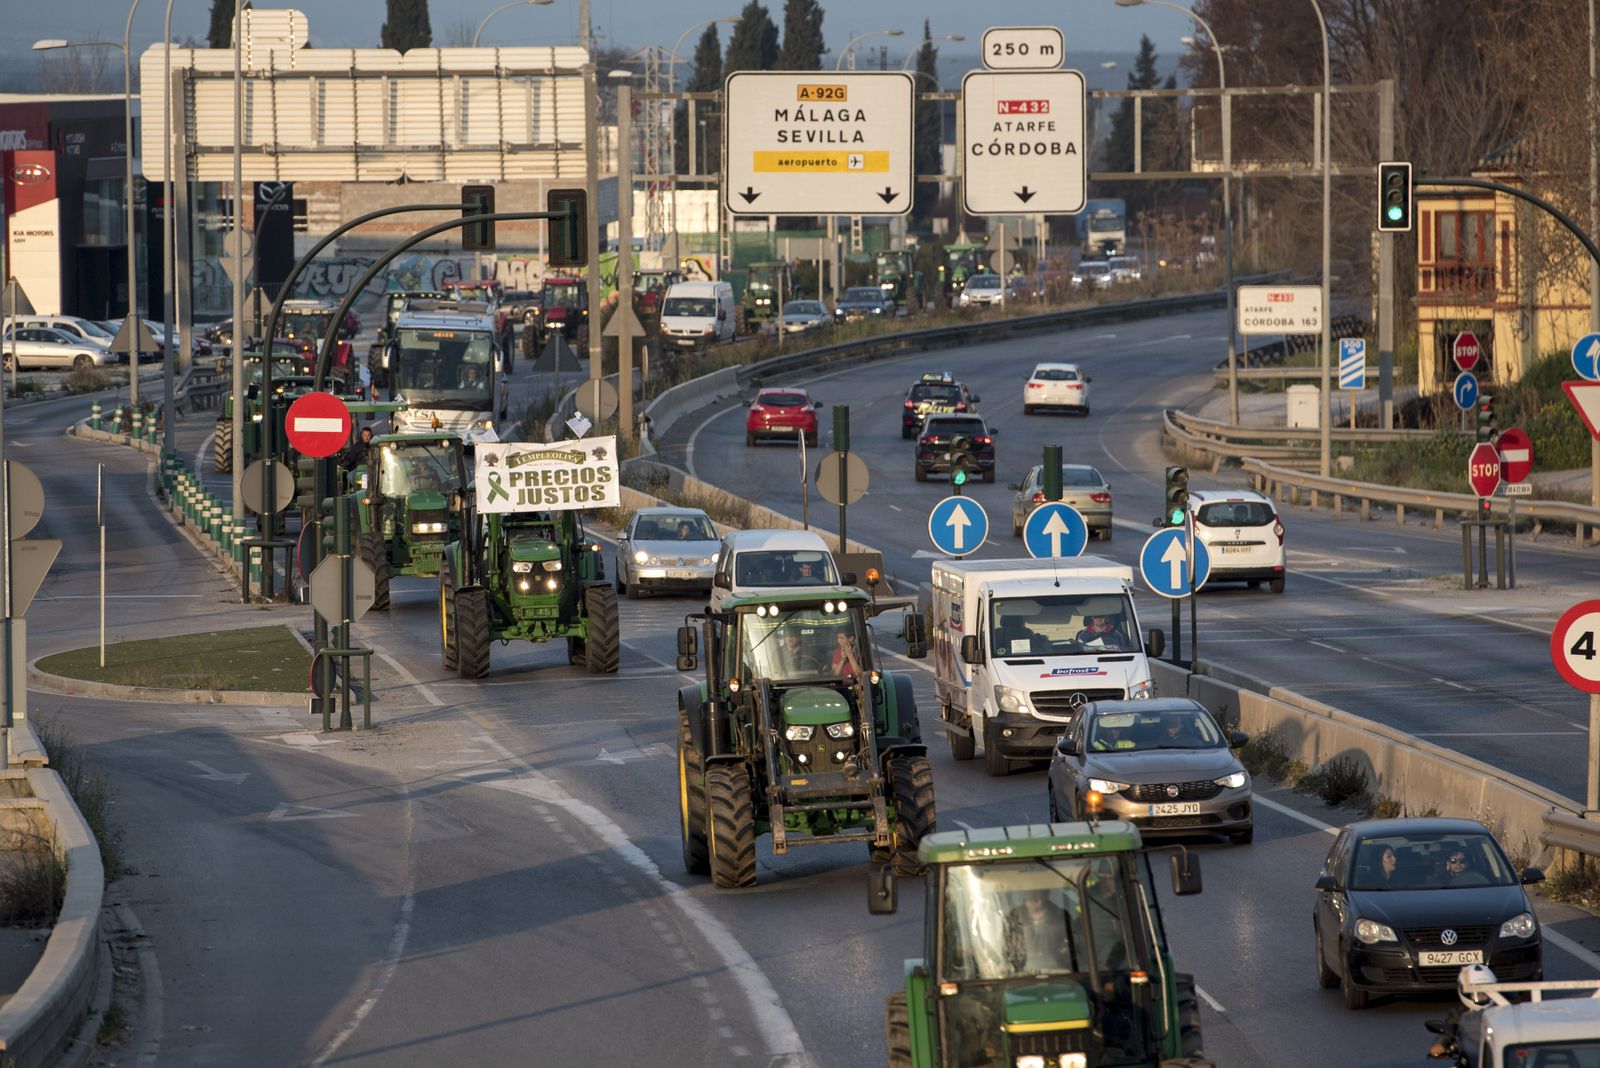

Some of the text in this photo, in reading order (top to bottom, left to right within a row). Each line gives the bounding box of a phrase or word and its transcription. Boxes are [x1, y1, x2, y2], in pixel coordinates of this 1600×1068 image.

[992, 42, 1054, 56] 250 m
[799, 87, 845, 99] A-92G
[774, 104, 867, 122] MÁLAGA
[998, 101, 1049, 113] N-432
[993, 121, 1056, 132] ATARFE
[777, 130, 865, 143] SEVILLA
[971, 138, 1077, 156] CÓRDOBA
[777, 157, 838, 168] aeropuerto
[1244, 305, 1273, 313] ATARFE
[1301, 318, 1318, 326] 163
[1456, 346, 1478, 357] STOP
[508, 466, 612, 487] PRECIOS
[1471, 463, 1499, 478] STOP
[516, 484, 606, 505] JUSTOS
[1155, 804, 1179, 814] 2425
[1427, 952, 1480, 963] 9427 GCX
